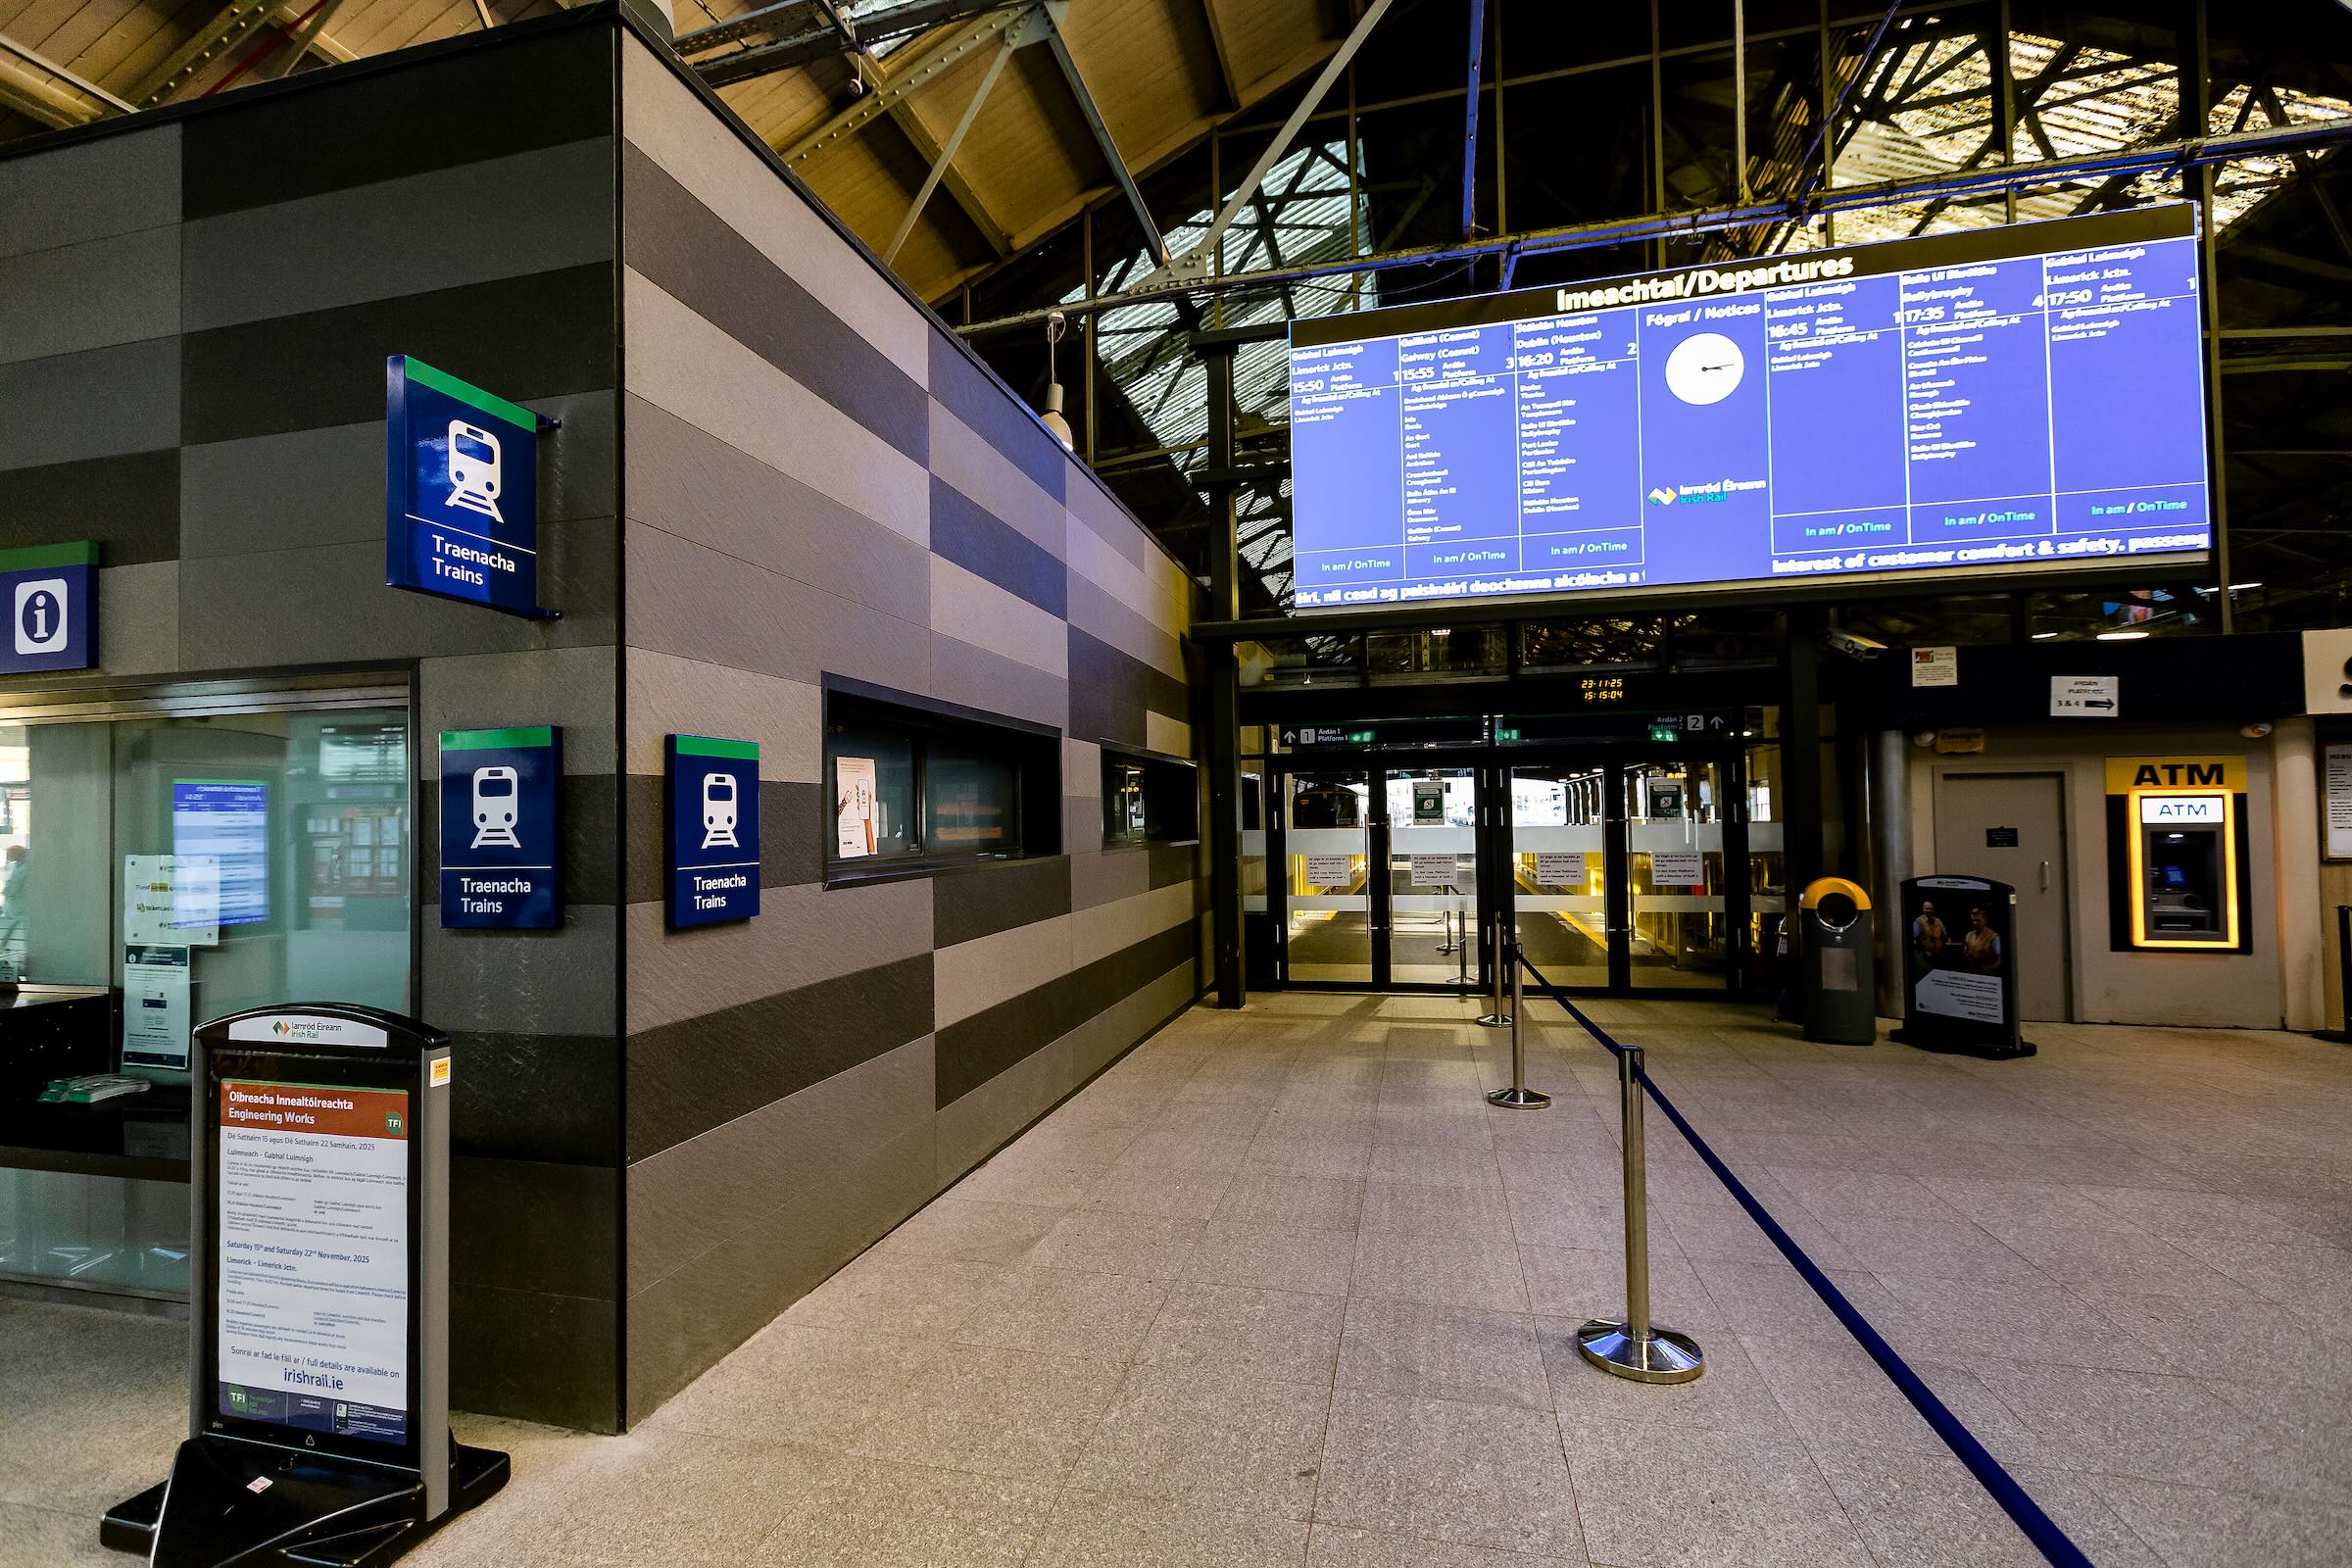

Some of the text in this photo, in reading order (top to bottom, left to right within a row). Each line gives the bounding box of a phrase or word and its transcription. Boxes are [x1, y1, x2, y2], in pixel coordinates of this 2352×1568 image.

[2048, 289, 2092, 306] 17:50
[1693, 308, 1702, 321] /
[1704, 303, 1760, 320] Notices
[1904, 306, 1944, 322] 17:35
[1768, 322, 1809, 338] 16:45
[1627, 342, 1637, 355] 2
[1505, 357, 1514, 369] 3
[1517, 353, 1553, 368] 16:20
[1393, 370, 1398, 381] 1
[1402, 367, 1435, 380] 15:55
[1293, 379, 1324, 393] 15:50
[1679, 492, 1727, 505] Irish Rail
[2091, 500, 2188, 515] In am / OnTime
[1944, 512, 2035, 526] In am / OnTime
[1805, 521, 1891, 536] In am / OnTime
[432, 535, 515, 573] Traenacha
[1578, 544, 1585, 554] /
[1587, 542, 1628, 553] OnTime
[1844, 553, 1866, 568] of
[1868, 550, 1955, 566] customer
[1957, 541, 2035, 561] comfort
[2037, 540, 2055, 556] &
[1433, 555, 1442, 564] In
[1459, 553, 1466, 563] /
[1468, 550, 1506, 561] OnTime
[432, 558, 484, 586] Trains
[1322, 563, 1331, 571] In
[1347, 561, 1352, 570] /
[1354, 559, 1391, 568] OnTime
[1344, 587, 1378, 602] cead
[1380, 587, 1398, 602] ag
[1629, 571, 1640, 583] a
[1584, 690, 1623, 700] 15:15:04
[1690, 716, 1700, 729] 2
[1303, 731, 1310, 742] 1
[2132, 763, 2225, 786] ATM
[2159, 805, 2207, 815] ATM
[461, 877, 531, 894] Traenacha
[694, 874, 747, 891] Traenacha
[461, 898, 503, 913] Trains
[694, 895, 726, 910] Trains
[291, 1021, 342, 1032] Iarnród Éireann
[228, 1092, 354, 1110] Oibreacha Innealtóireachta
[228, 1107, 315, 1125] Engineering Works
[388, 1118, 402, 1128] TFI
[237, 1133, 261, 1142] Sathairn
[295, 1138, 319, 1147] Sathairn
[329, 1141, 358, 1151] Samhain,
[359, 1143, 375, 1152] 2025
[227, 1149, 314, 1163] Luimneach Gabhal Luimnigh
[226, 1240, 253, 1251] Saturday
[264, 1245, 275, 1253] and
[275, 1247, 304, 1257] Saturday
[318, 1250, 352, 1263] November,
[353, 1254, 370, 1263] 2025
[226, 1256, 298, 1272] Limerick Limerick Jctn.
[261, 1350, 272, 1359] fad
[281, 1353, 292, 1363] fáil
[301, 1356, 306, 1366] /
[307, 1357, 318, 1367] full
[319, 1359, 343, 1371] details
[344, 1364, 356, 1373] are
[357, 1364, 389, 1378] available
[284, 1367, 344, 1390] irishrail.ie
[230, 1392, 246, 1403] TFI
